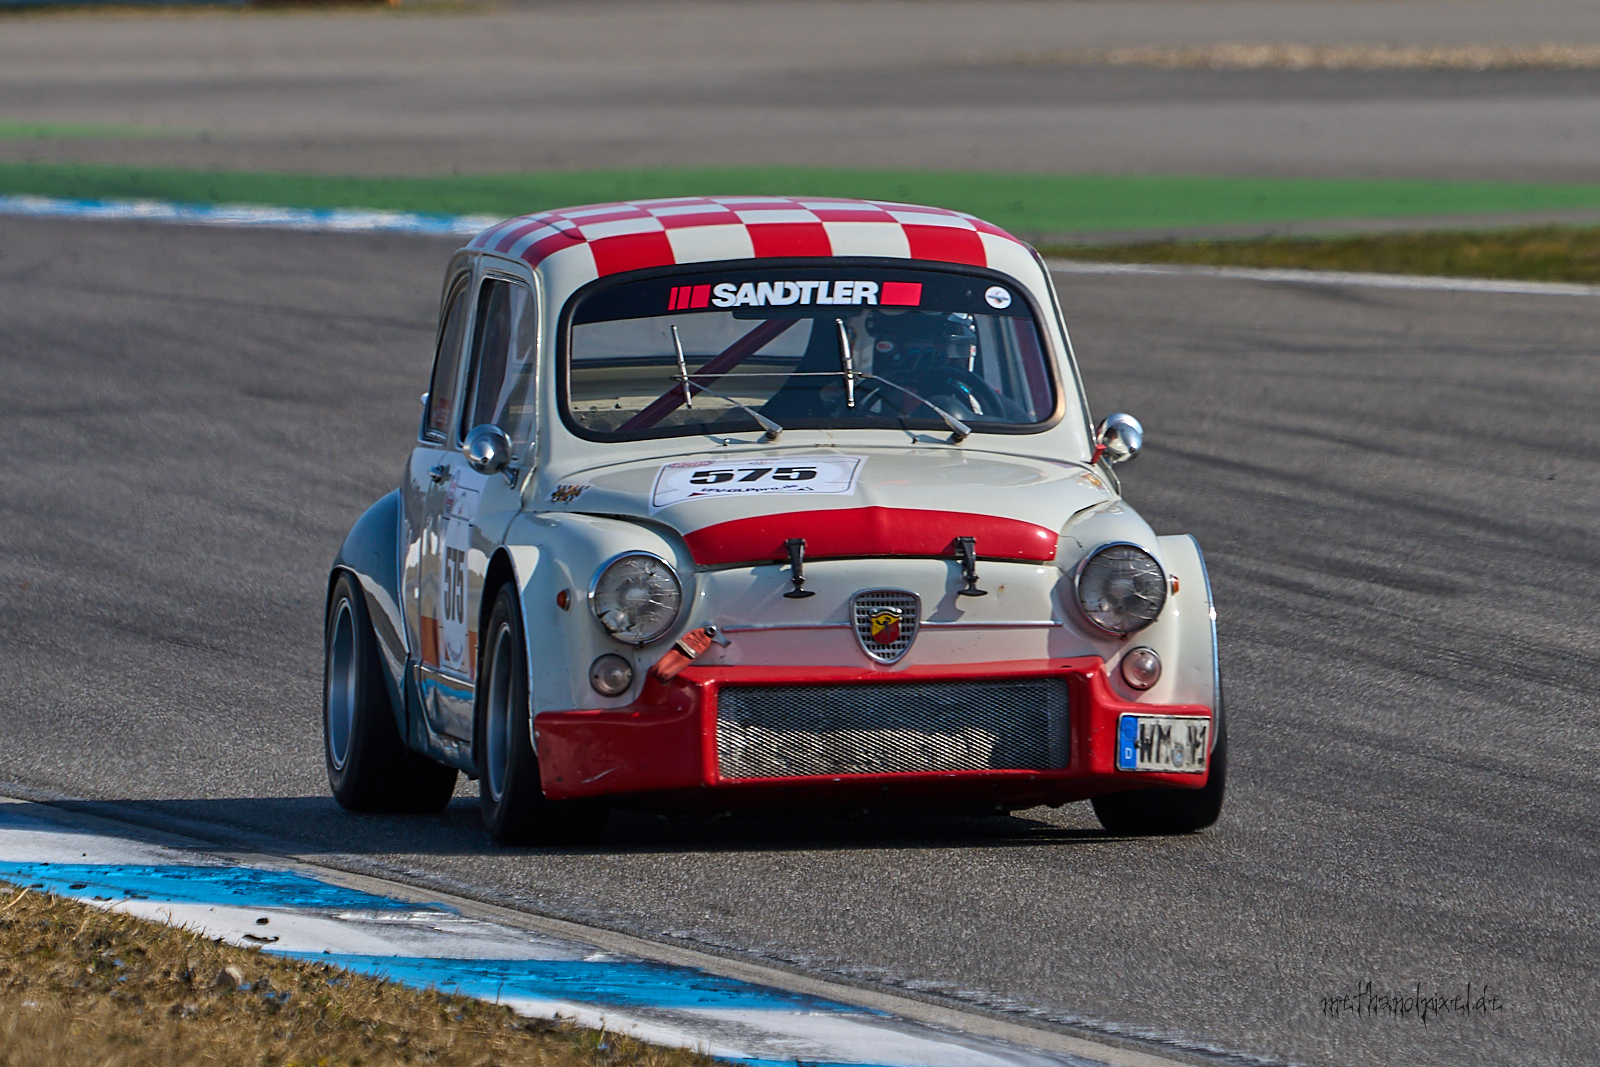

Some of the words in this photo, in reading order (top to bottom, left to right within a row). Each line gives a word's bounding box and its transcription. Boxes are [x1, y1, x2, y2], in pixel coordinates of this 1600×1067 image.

[711, 280, 878, 307] SANDTLER
[689, 466, 817, 485] 575
[444, 546, 465, 624] 575
[1124, 747, 1133, 760] D
